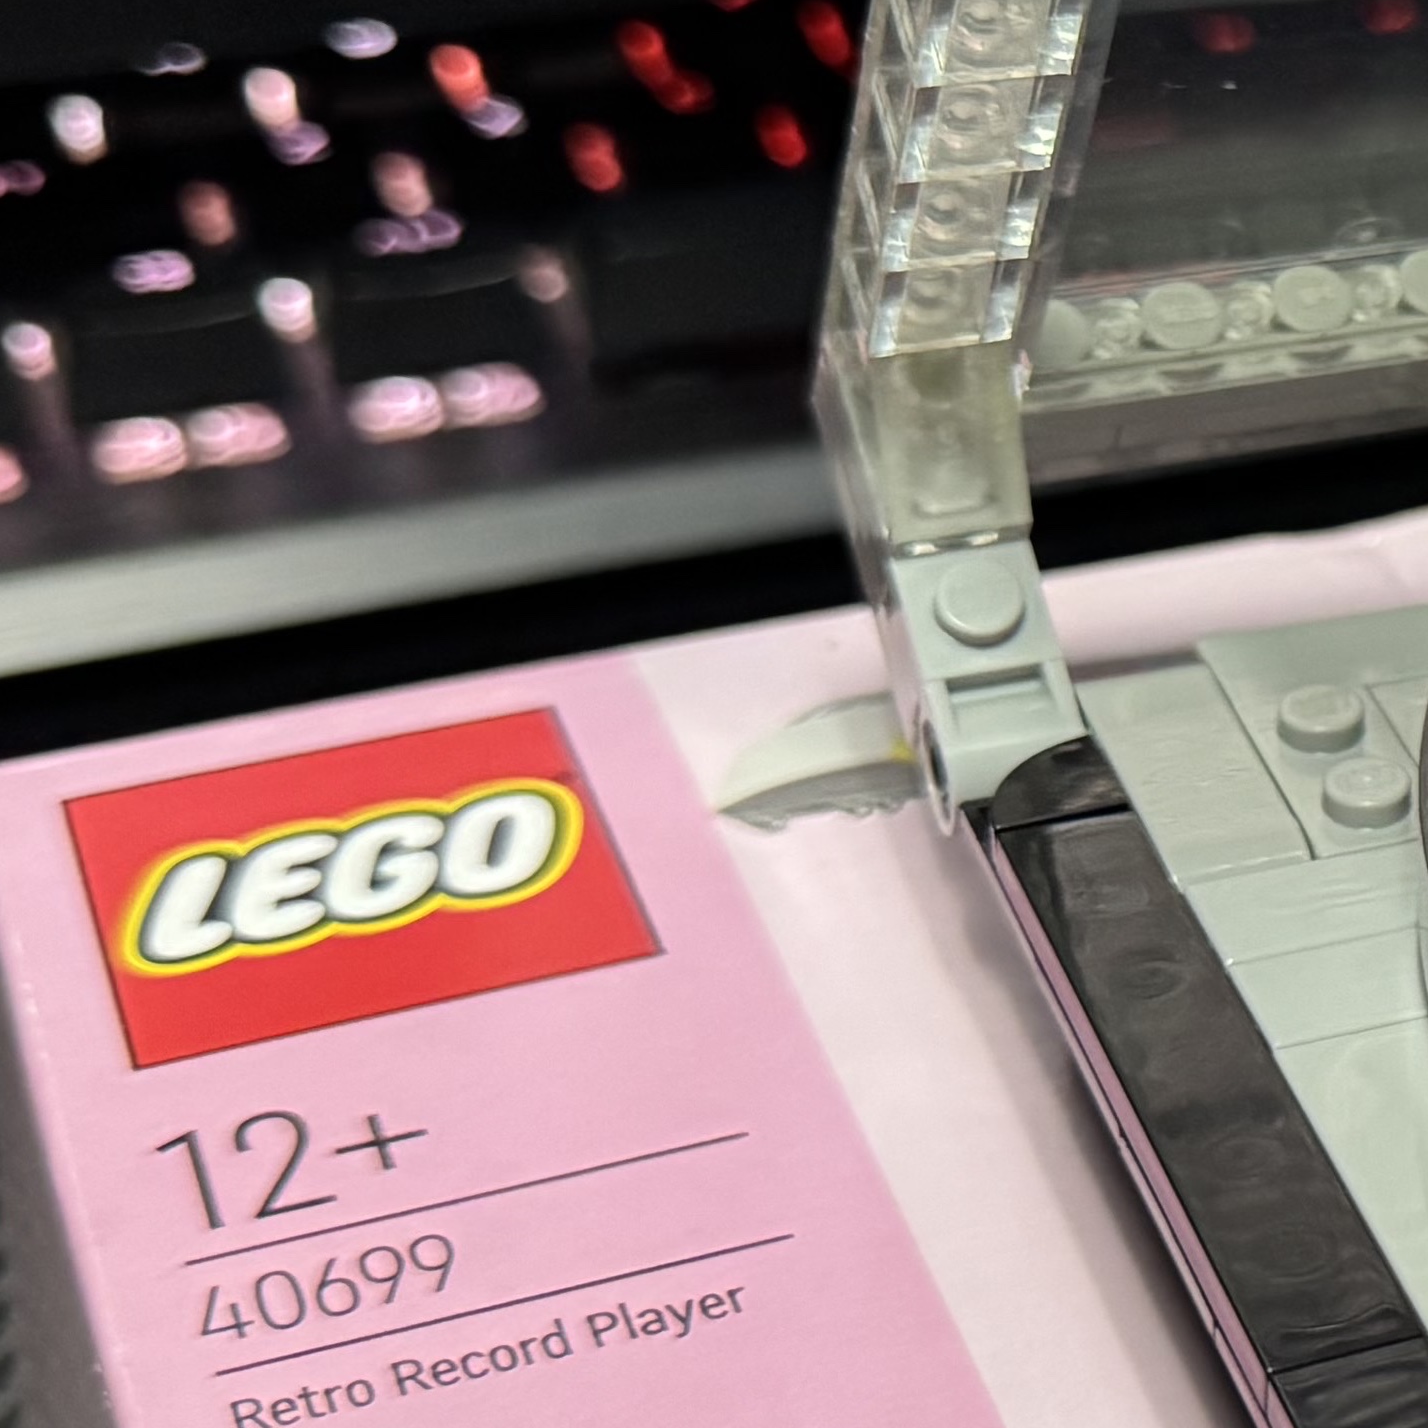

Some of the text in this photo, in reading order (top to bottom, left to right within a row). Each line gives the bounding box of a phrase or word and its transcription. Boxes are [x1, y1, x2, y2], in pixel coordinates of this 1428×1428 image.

[138, 789, 562, 963] LEGO
[155, 1109, 428, 1230] 12+
[200, 1232, 457, 1340] 40699
[391, 1318, 573, 1396] Record
[589, 1285, 746, 1348] Player
